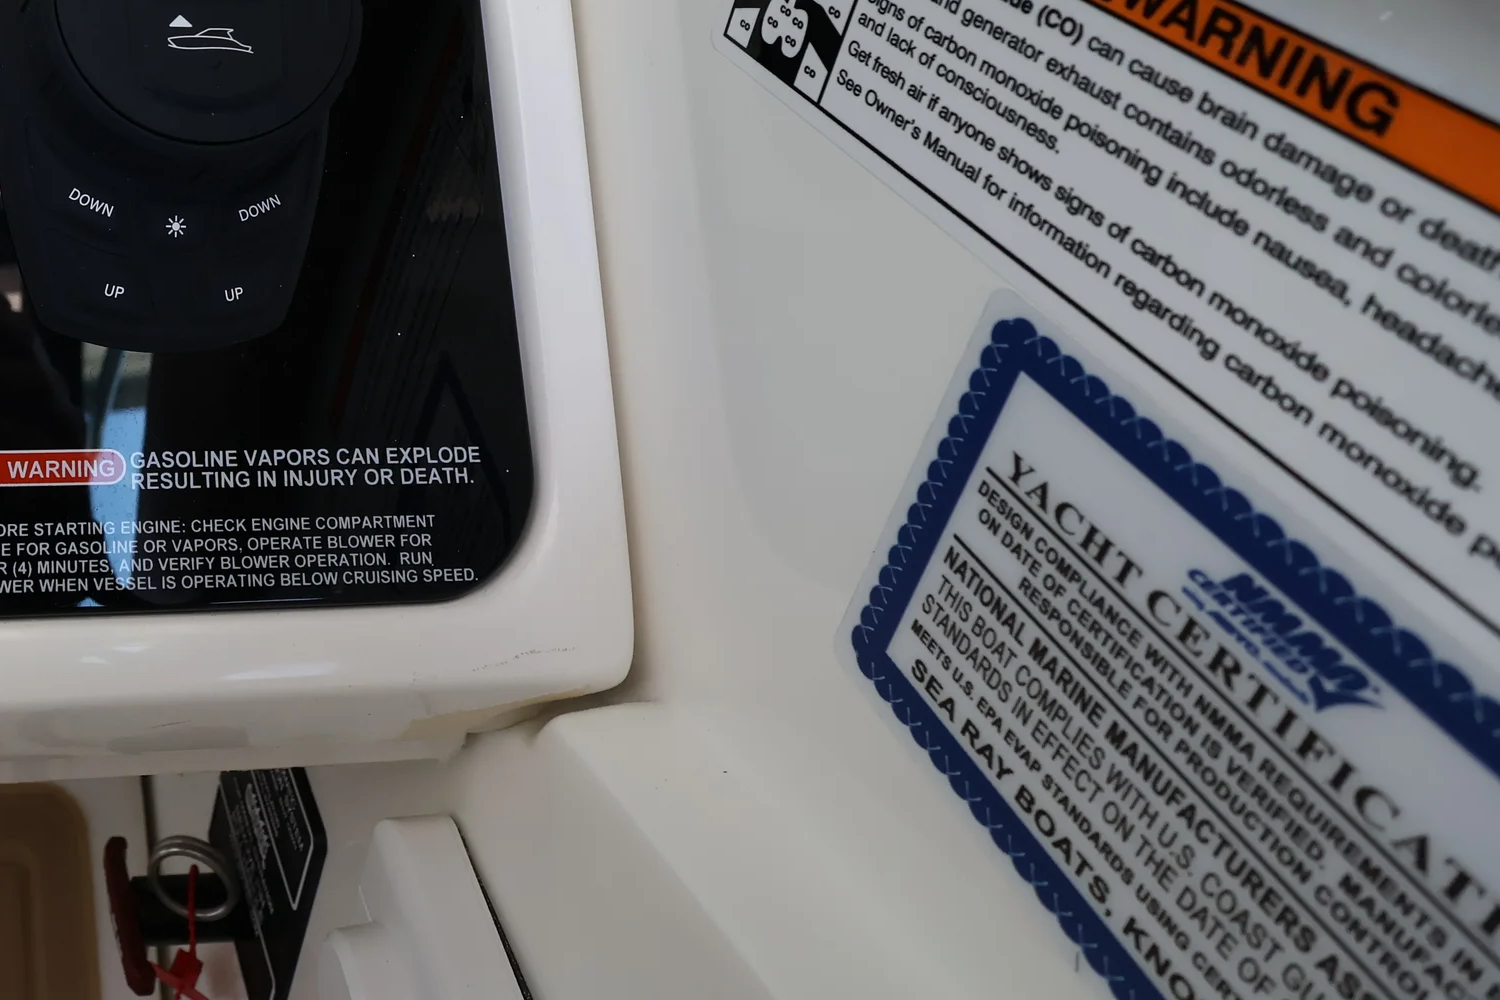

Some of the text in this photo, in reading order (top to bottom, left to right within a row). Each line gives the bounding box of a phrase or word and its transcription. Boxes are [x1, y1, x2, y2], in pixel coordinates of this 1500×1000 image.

[858, 12, 1060, 154] and lack of consciousness.
[1037, 5, 1084, 45] (CO)
[1087, 36, 1125, 66] can
[1128, 59, 1194, 103] cause
[1197, 91, 1259, 140] brain
[1263, 131, 1375, 202] damage
[1379, 197, 1415, 224] or
[907, 12, 925, 32] of
[924, 25, 977, 67] carbon
[979, 58, 1064, 121] monoxide
[1063, 114, 1164, 188] poisoning
[1166, 171, 1251, 238] include
[1253, 230, 1352, 308] nausea,
[961, 8, 1044, 63] generator
[1045, 54, 1122, 111] exhaust
[1123, 100, 1216, 166] contains
[1219, 159, 1330, 233] odorless
[1333, 225, 1395, 271] and
[68, 188, 114, 218] DOWN
[238, 194, 281, 221] DOWN
[104, 283, 125, 299] UP
[224, 286, 243, 302] UP
[836, 69, 862, 97] See
[923, 131, 982, 184] Manual
[982, 174, 1008, 201] for
[1010, 194, 1113, 280] information
[1114, 271, 1220, 362] regarding
[1224, 350, 1314, 428] carbon
[1318, 421, 1468, 539] monoxide
[848, 40, 1481, 493] Get fresh air if anyone shows signs of carbon monoxide poisoning.
[6, 459, 116, 480] WARNING
[130, 446, 481, 470] GASOLINE VAPORS CAN EXPLODE
[130, 466, 475, 491] RESULTING IN INJURY OR DEATH.
[16, 542, 51, 557] FOR
[54, 536, 139, 557] GASOLINE
[143, 539, 167, 554] OR
[171, 537, 243, 553] VAPORS,
[247, 535, 323, 551] OPERATE
[327, 534, 396, 549] BLOWER
[400, 533, 432, 547] FOR
[33, 520, 115, 537] STARTING
[121, 519, 186, 535] ENGINE:
[190, 518, 247, 533] CHECK
[251, 517, 311, 532] ENGINE
[315, 514, 436, 530] COMPARTMENT
[1009, 451, 1143, 589] YACHT
[12, 561, 33, 578] (4)
[37, 556, 116, 575] MINUTES,
[118, 555, 154, 574] AND
[157, 556, 215, 571] VERIFY
[220, 554, 291, 570] BLOWER
[294, 552, 391, 568] OPERATION.
[399, 551, 433, 565] RUN
[38, 577, 89, 593] WHEN
[93, 573, 158, 591] VESSEL
[161, 575, 177, 590] IS
[181, 573, 276, 589] OPERATING
[280, 571, 338, 587] BELOW
[342, 569, 418, 585] CRUISING
[422, 567, 479, 583] SPEED.
[944, 546, 1034, 647] NATIONAL
[1028, 638, 1107, 728] MARINE
[1104, 721, 1317, 954] MANUFACTURERS
[977, 480, 1035, 539] DESIGN
[1034, 535, 1143, 647] COMPLIANCE
[1144, 643, 1193, 698] WITH
[1193, 695, 1255, 762] NMMA
[1258, 757, 1448, 948] REQUIREMENTS
[911, 658, 1112, 918] SEA RAY BOATS,
[938, 575, 1285, 963] THIS BOAT COMPLIES WITH U.S. COAST
